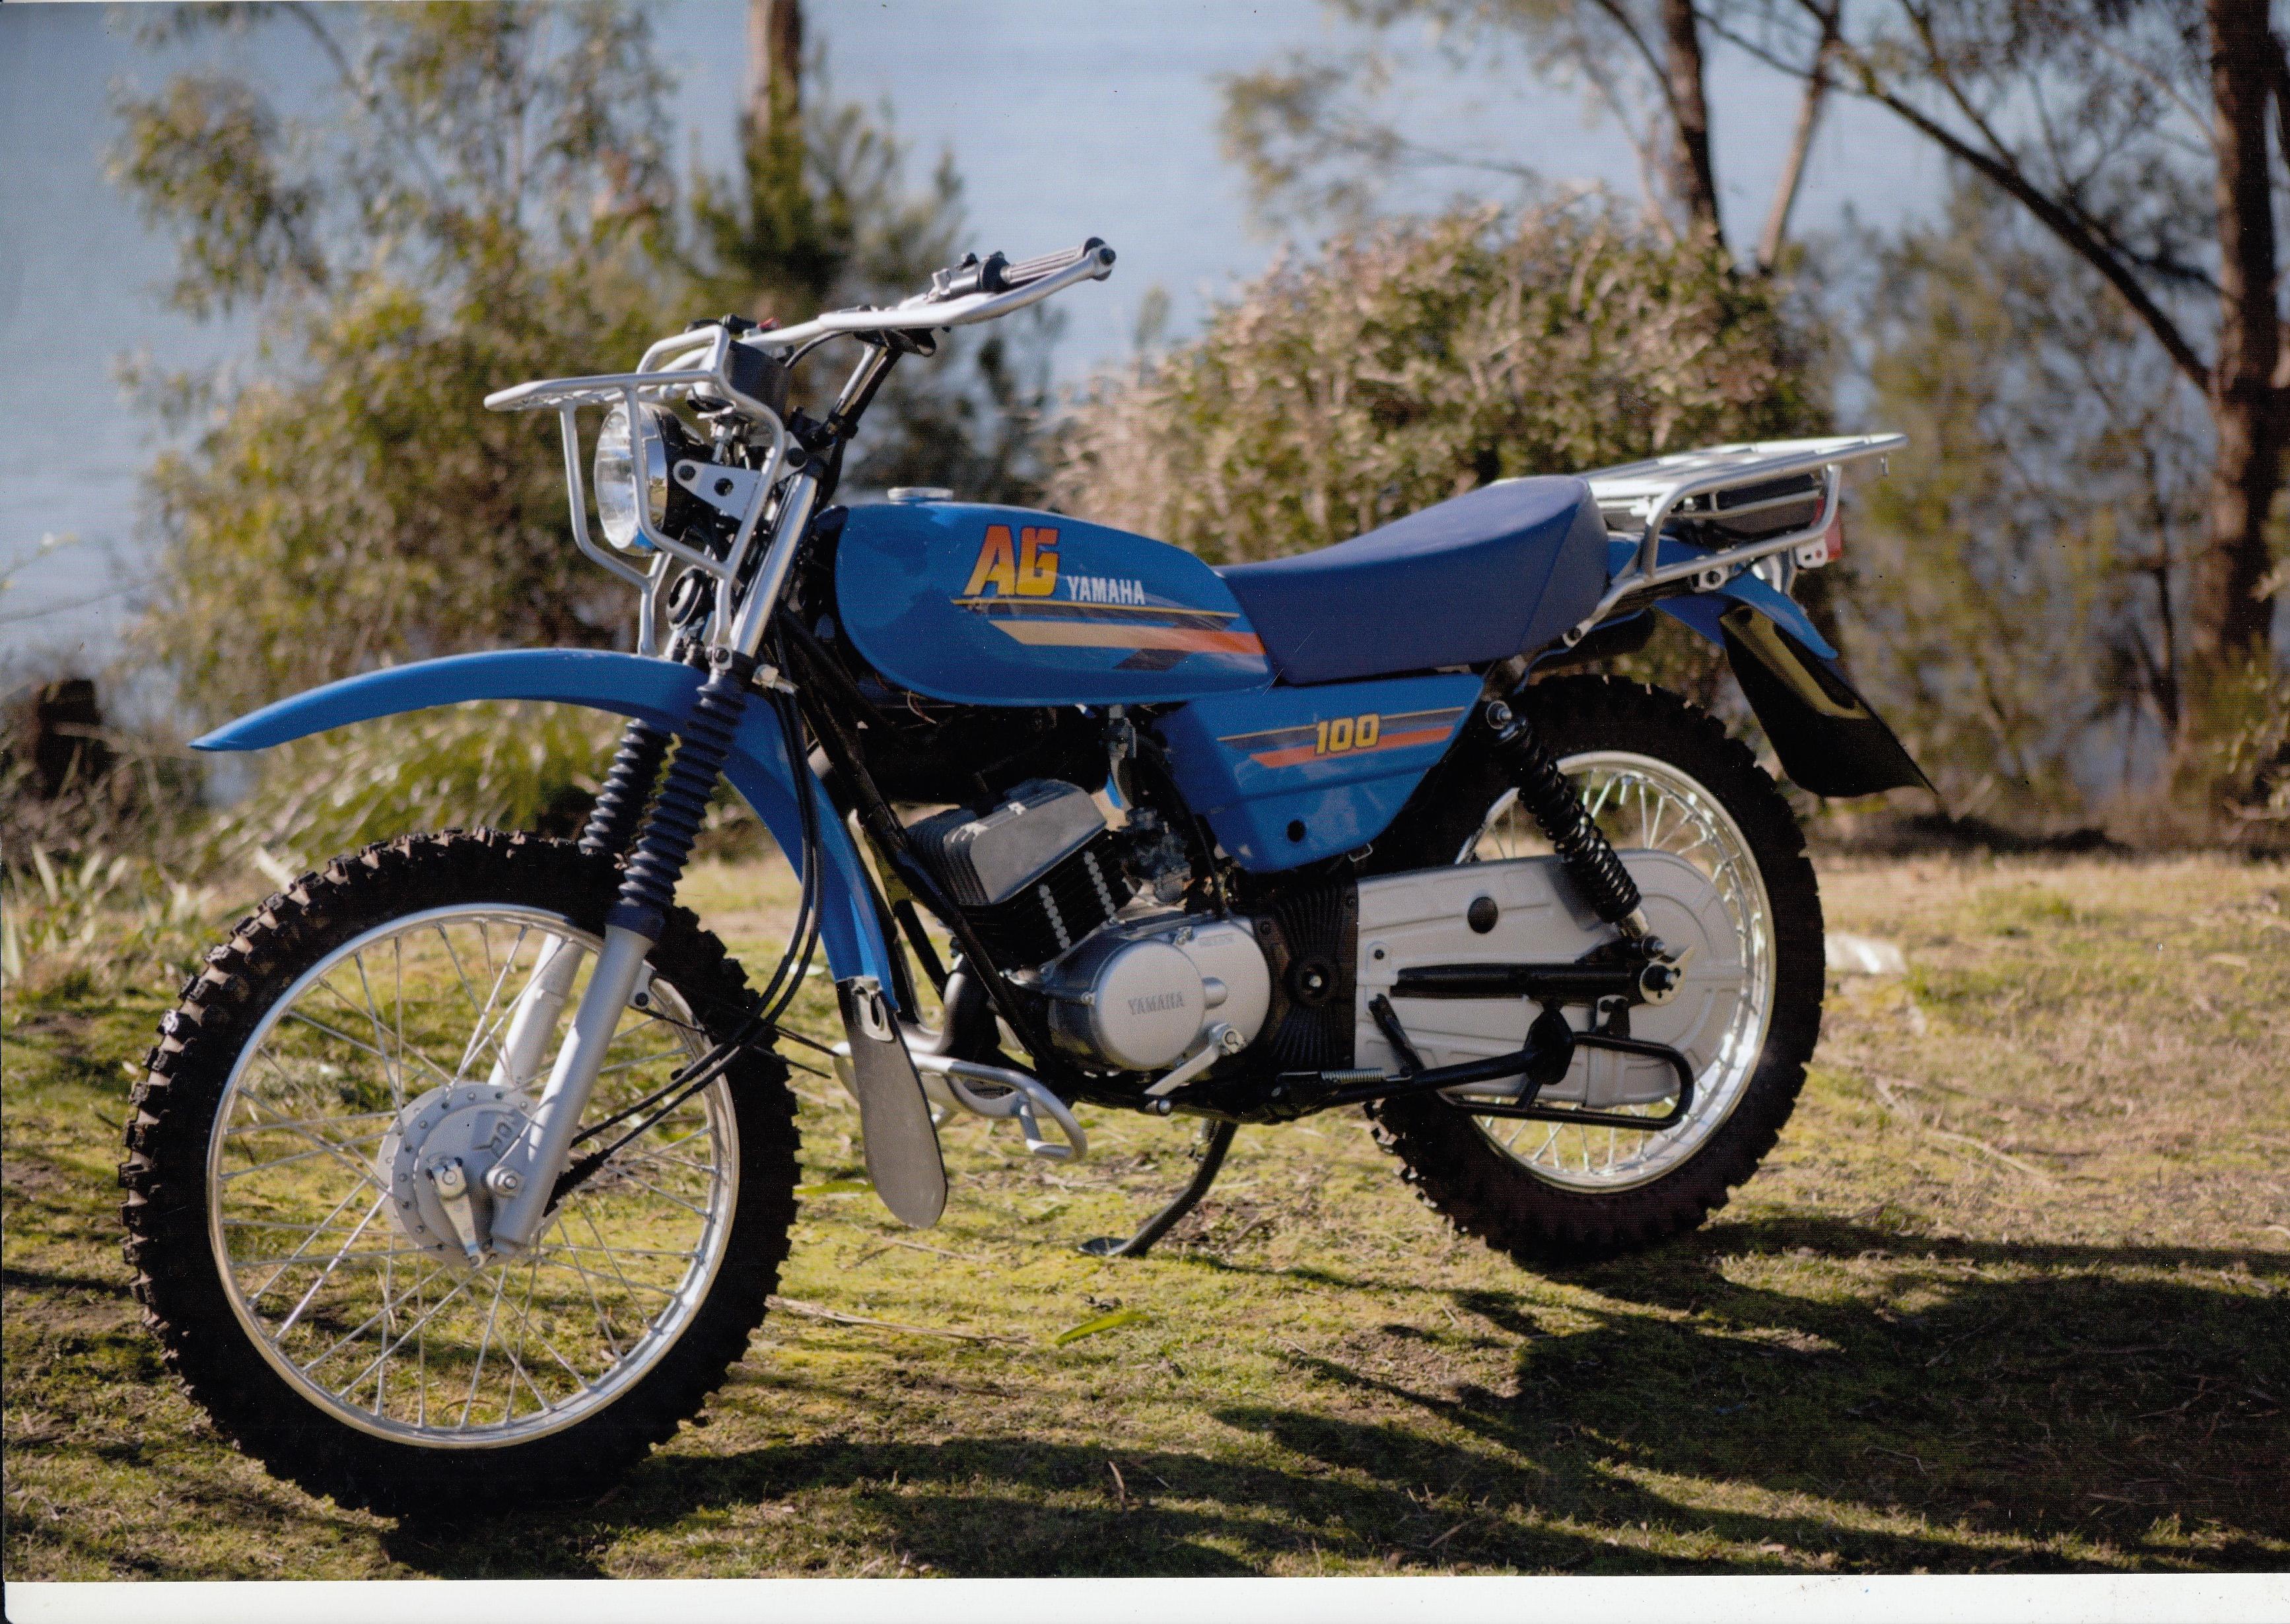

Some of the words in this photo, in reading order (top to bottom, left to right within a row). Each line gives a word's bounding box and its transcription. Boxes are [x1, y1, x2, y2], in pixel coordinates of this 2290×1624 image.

[963, 524, 1060, 597] AG
[1066, 575, 1146, 605] YAMAHA
[1315, 713, 1381, 755] 100
[1127, 992, 1185, 1015] YAMAHA
